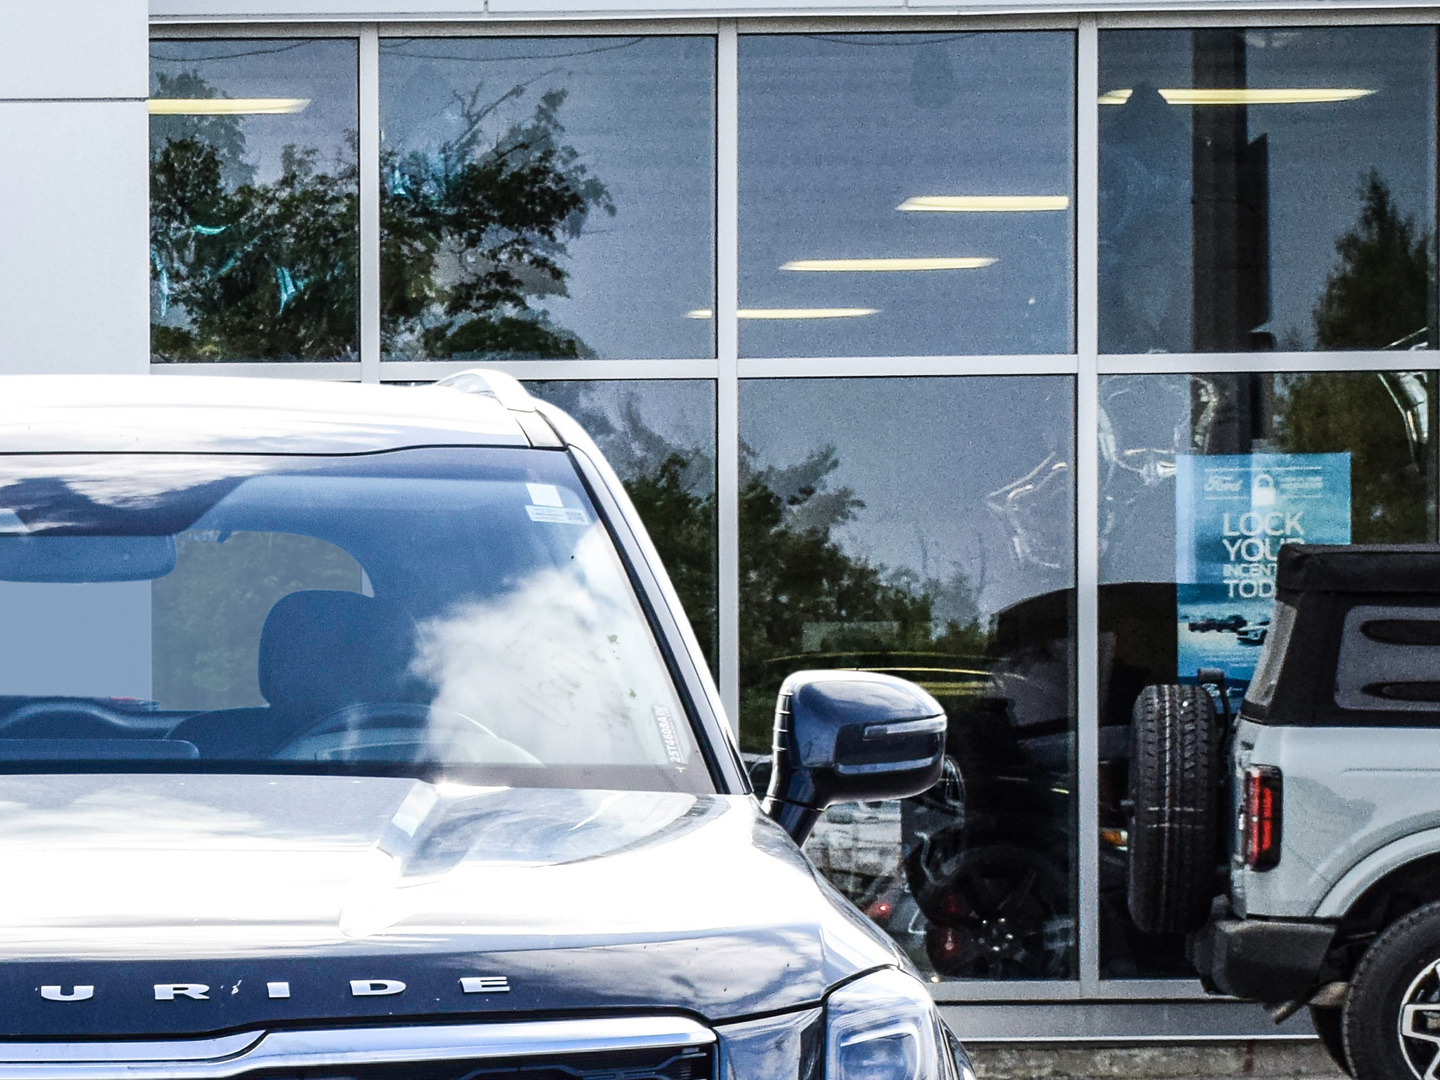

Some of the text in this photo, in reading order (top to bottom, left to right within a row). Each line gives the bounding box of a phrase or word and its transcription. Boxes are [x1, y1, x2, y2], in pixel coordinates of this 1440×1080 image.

[1222, 511, 1305, 536] LOCK
[1222, 537, 1305, 561] YOU
[1223, 579, 1276, 598] TOD
